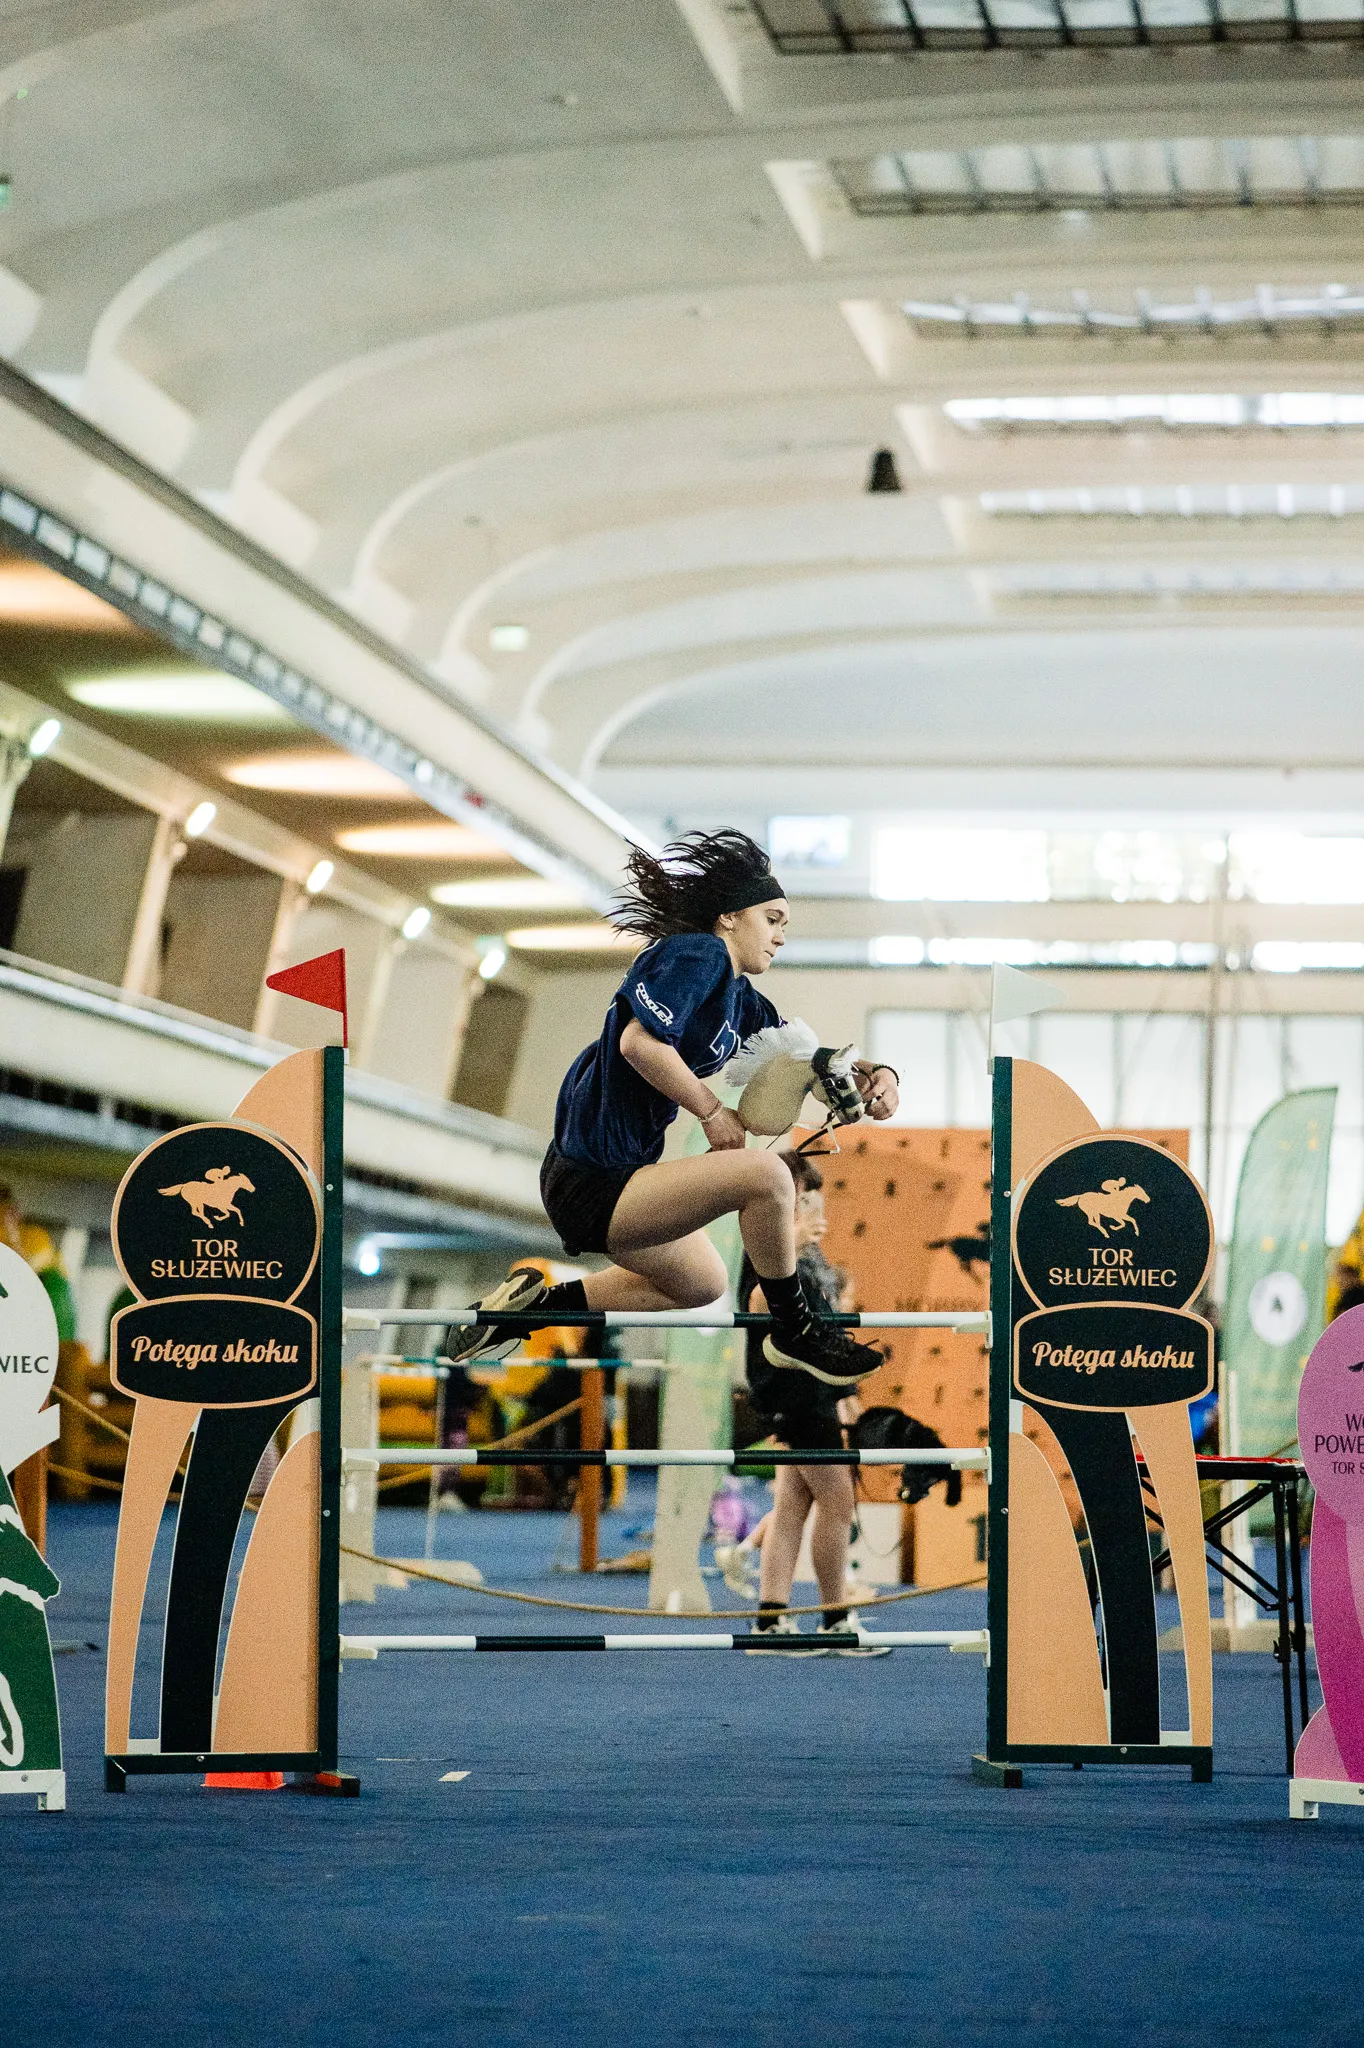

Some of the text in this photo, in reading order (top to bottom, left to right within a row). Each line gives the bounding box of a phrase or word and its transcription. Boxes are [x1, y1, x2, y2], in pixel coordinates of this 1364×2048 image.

[636, 982, 673, 1027] CONQUER
[191, 1239, 238, 1258] TOR
[1088, 1248, 1134, 1266] TOR
[131, 1336, 299, 1370] Potęga skoku
[1031, 1341, 1195, 1375] Potęga skoku
[1345, 1413, 1364, 1432] W
[1332, 1461, 1356, 1475] TOR
